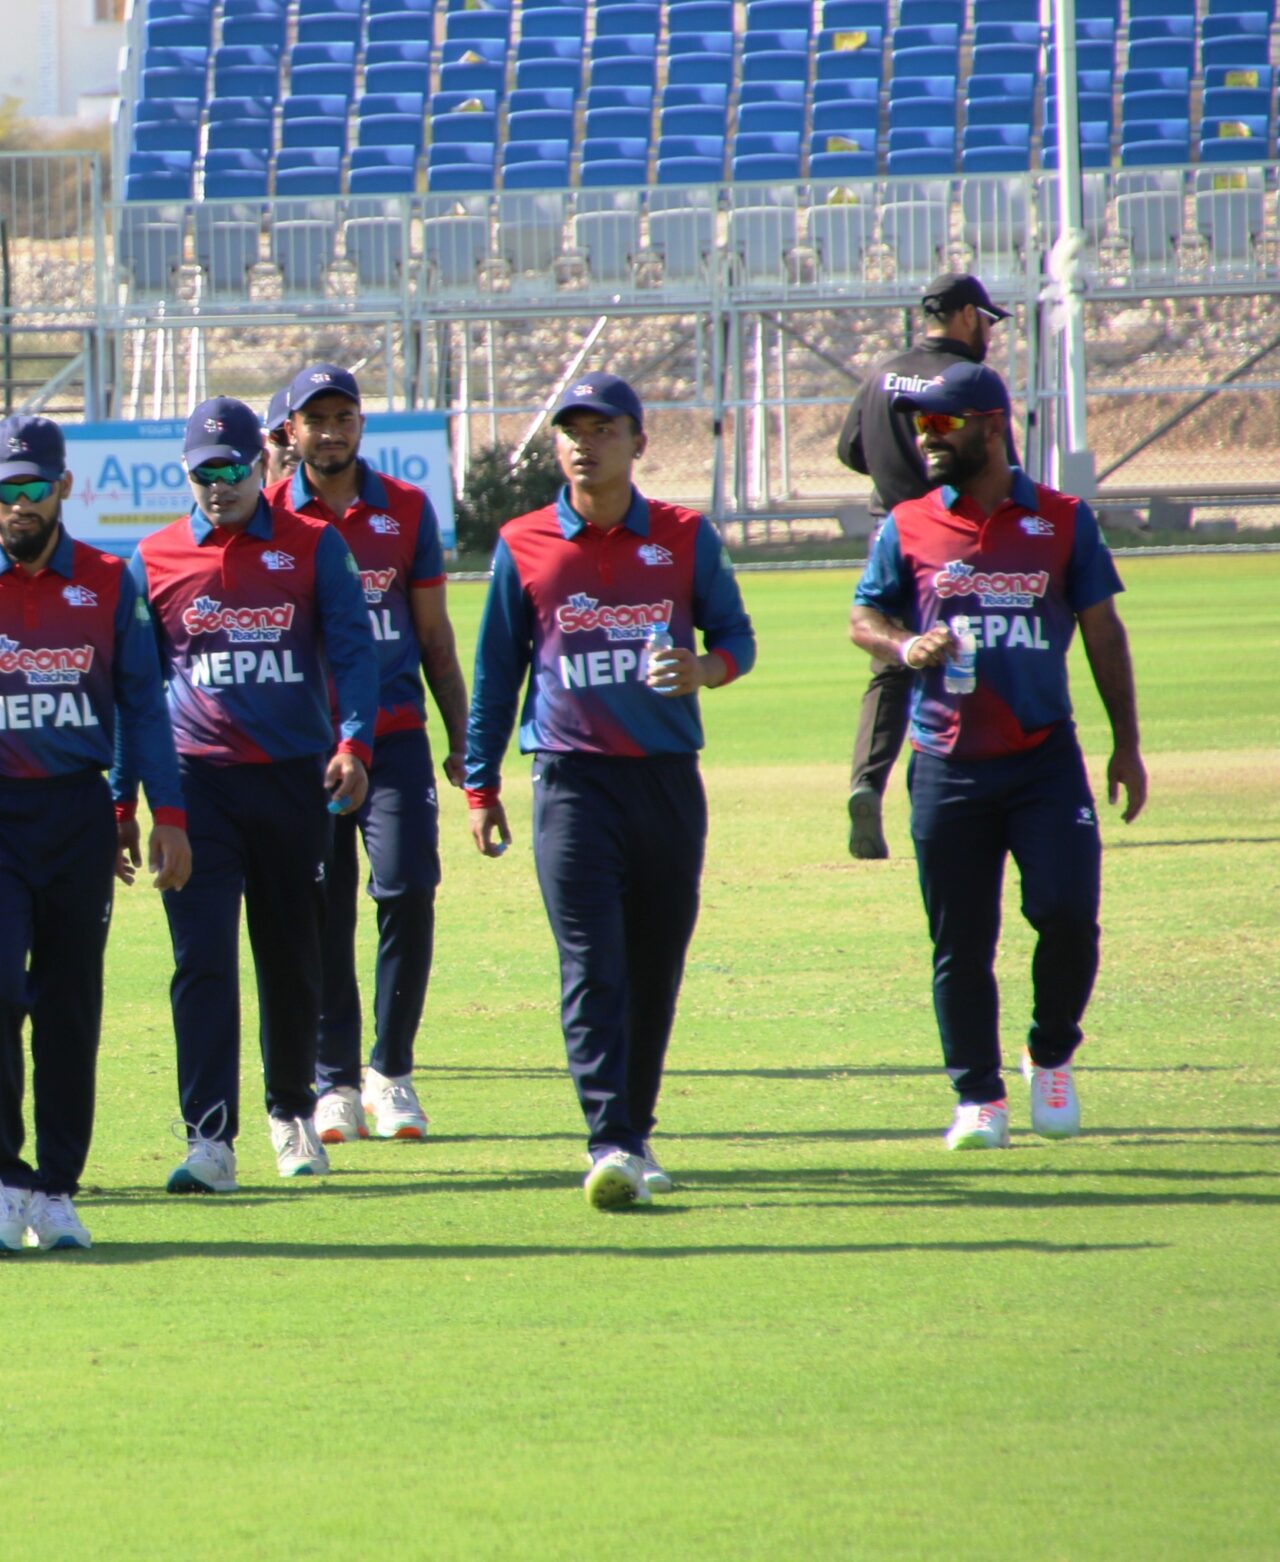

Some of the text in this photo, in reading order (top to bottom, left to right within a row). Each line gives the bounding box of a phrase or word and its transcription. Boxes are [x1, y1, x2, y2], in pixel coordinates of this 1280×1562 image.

[884, 372, 933, 392] Emir
[97, 454, 186, 506] Apo
[946, 561, 973, 576] My
[934, 571, 1048, 598] Second
[194, 597, 220, 613] My
[571, 593, 596, 610] My
[183, 603, 294, 635] Second
[558, 600, 672, 632] Second
[229, 628, 280, 642] Teacher
[937, 615, 1050, 650] EPAL
[27, 671, 80, 684] Teacher
[191, 650, 304, 687] NEPAL
